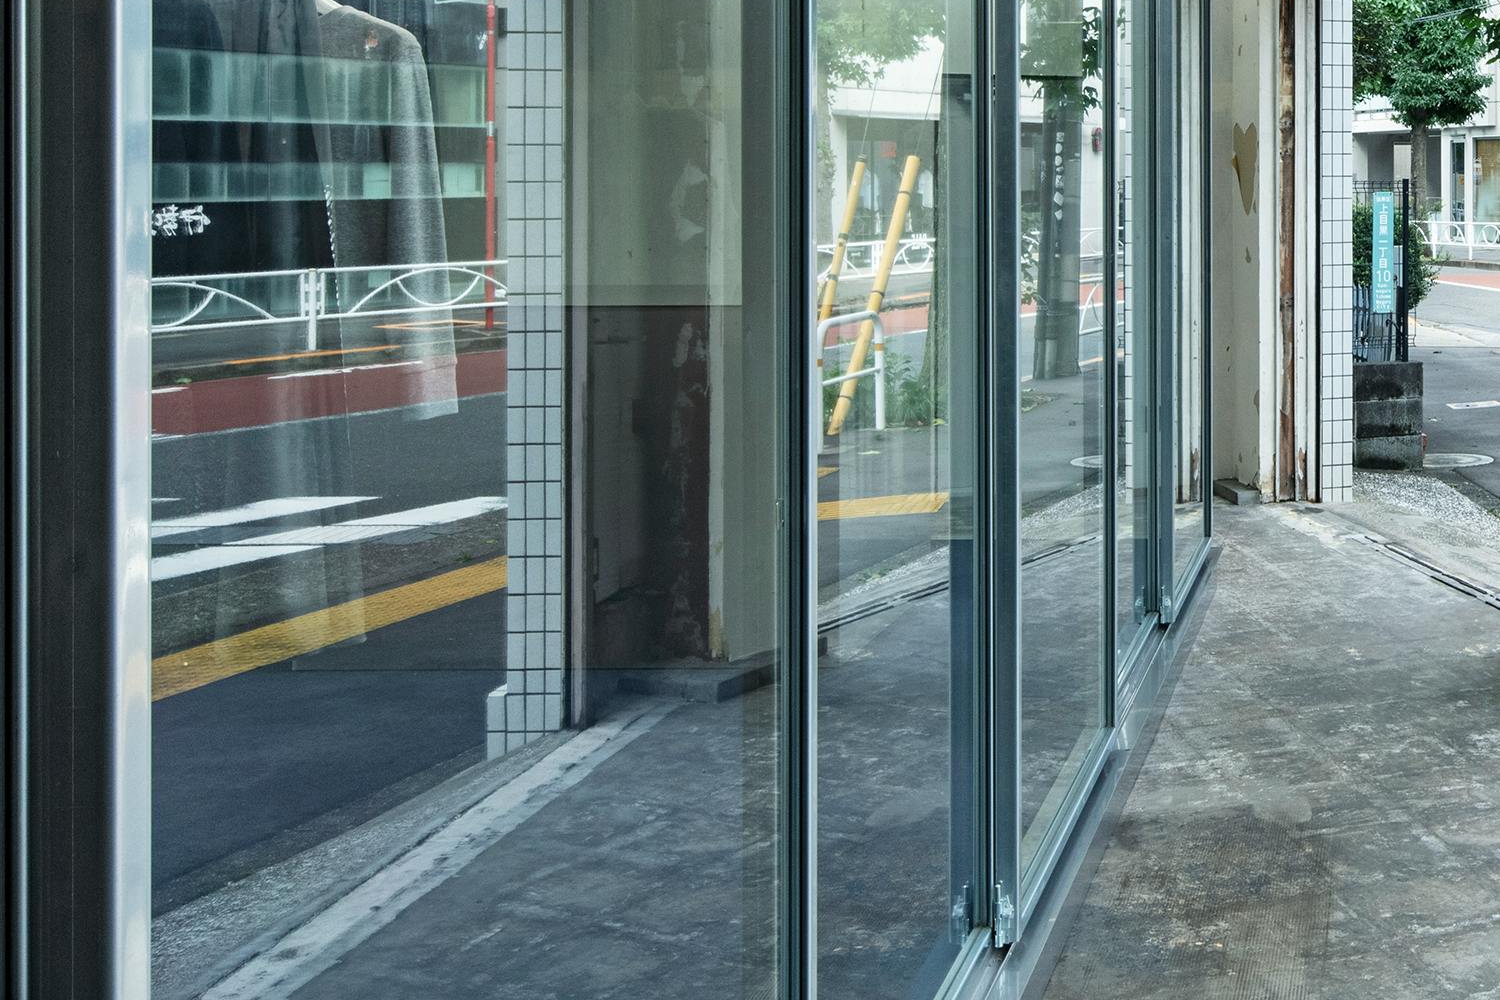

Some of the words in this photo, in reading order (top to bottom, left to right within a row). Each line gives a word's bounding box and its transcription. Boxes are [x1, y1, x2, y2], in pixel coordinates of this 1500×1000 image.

[1378, 203, 1389, 269] 上目黒一丁目
[1376, 270, 1391, 282] 10
